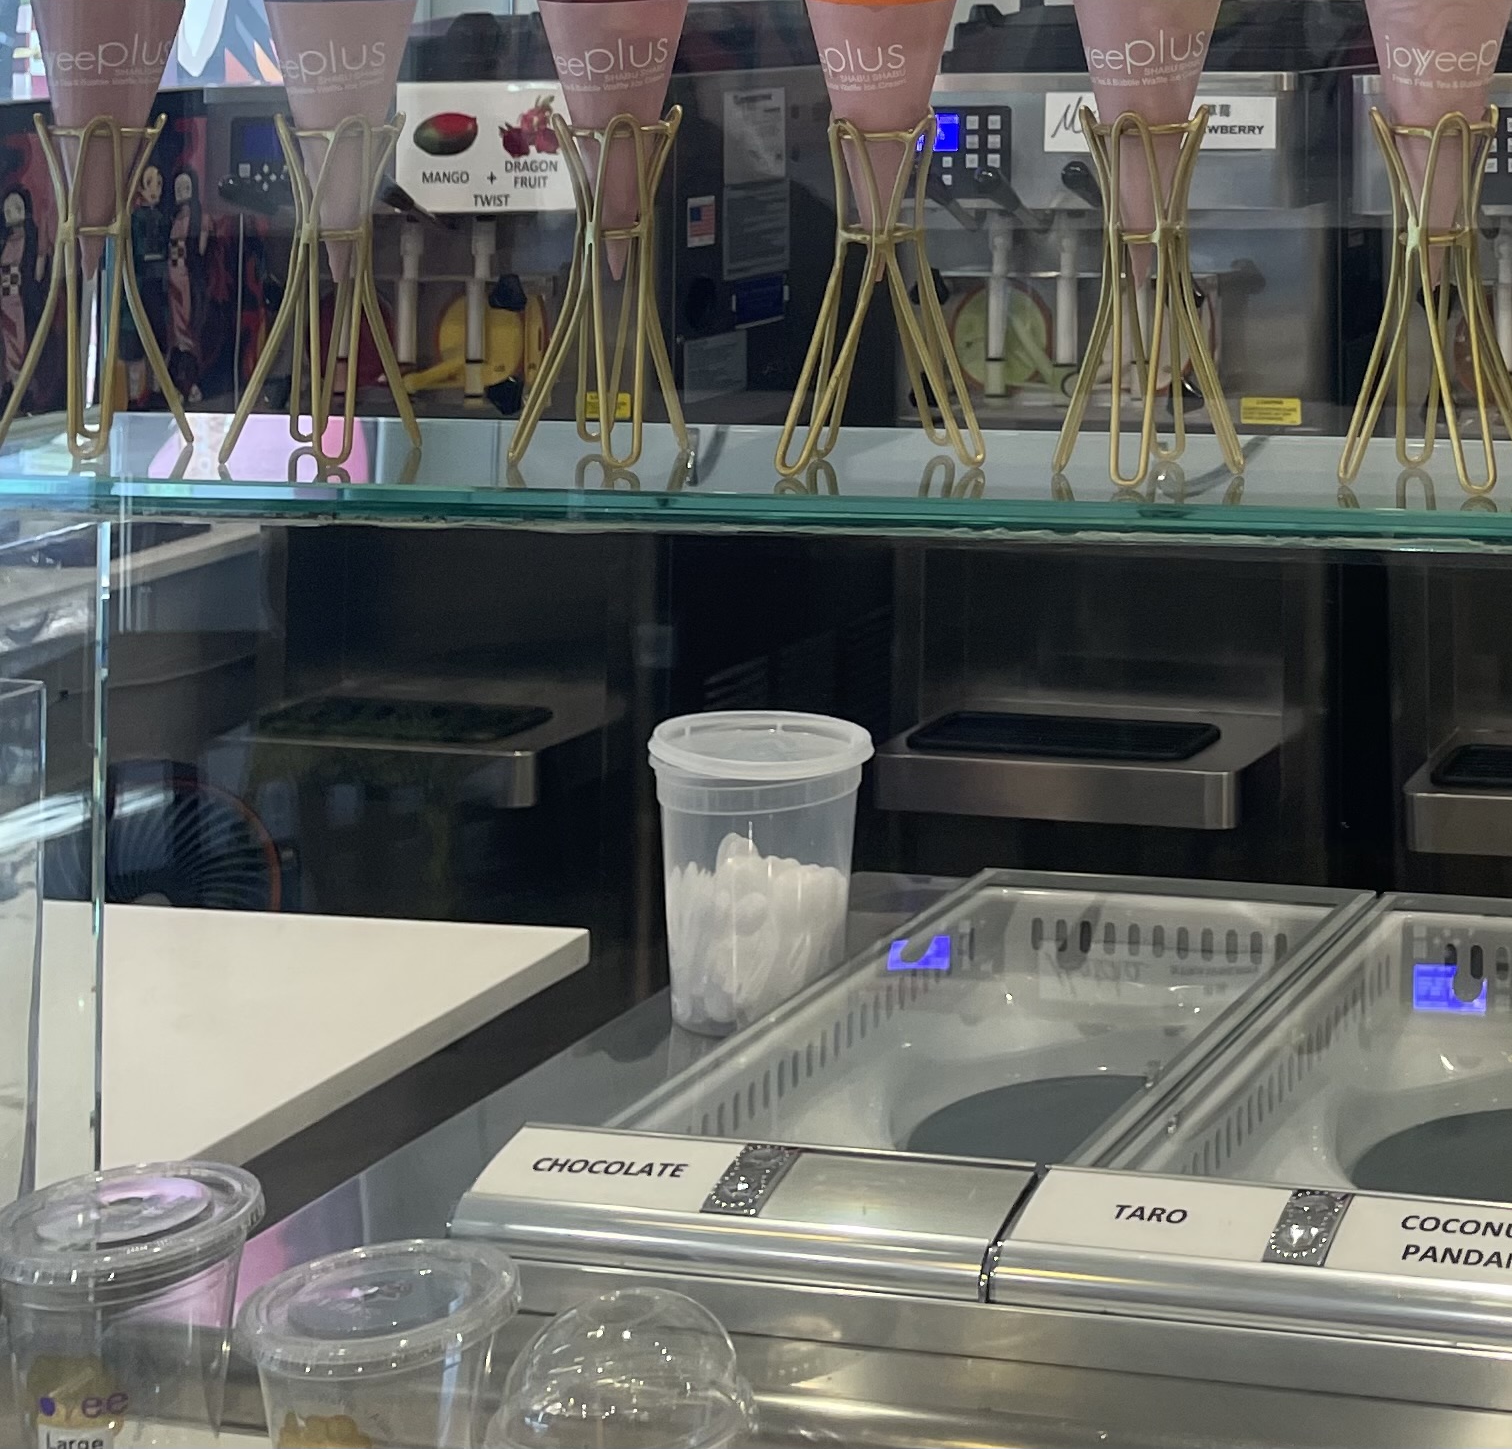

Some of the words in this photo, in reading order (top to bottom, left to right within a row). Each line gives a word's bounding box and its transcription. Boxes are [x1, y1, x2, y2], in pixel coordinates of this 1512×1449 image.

[53, 33, 172, 74] eeplus
[1204, 125, 1264, 134] WBERRY
[504, 160, 558, 173] DRAGON
[422, 170, 469, 185] MANGO
[513, 175, 548, 188] FRUIT
[474, 193, 510, 207] TWIST
[532, 1157, 688, 1179] CHOCOLATE
[1114, 1204, 1188, 1224] TARO
[47, 1430, 103, 1449] Large
